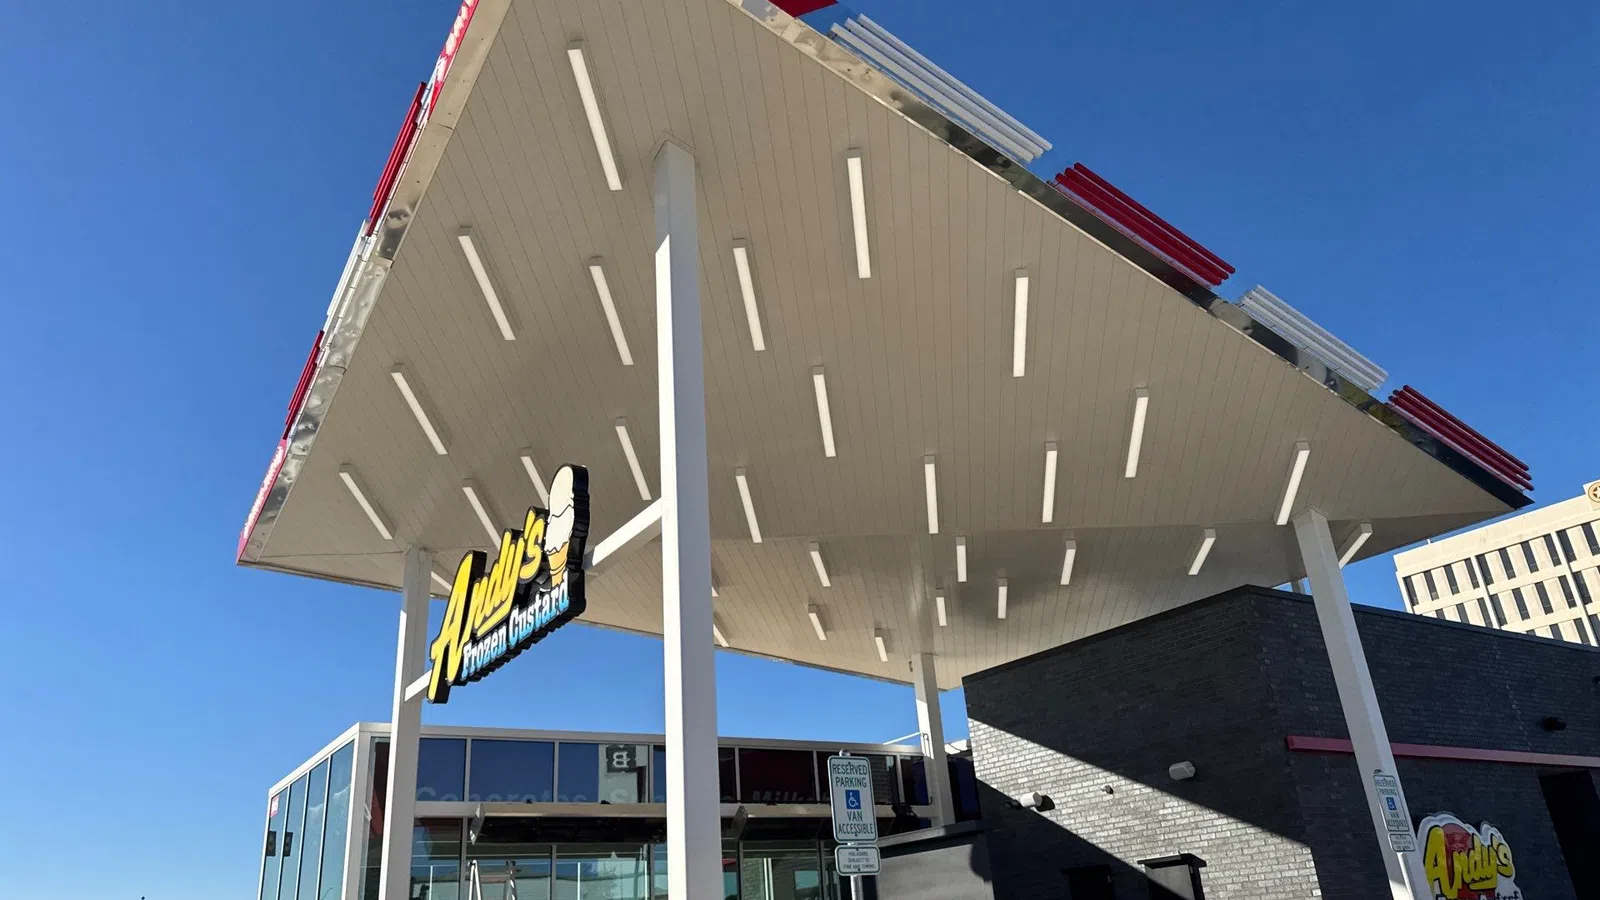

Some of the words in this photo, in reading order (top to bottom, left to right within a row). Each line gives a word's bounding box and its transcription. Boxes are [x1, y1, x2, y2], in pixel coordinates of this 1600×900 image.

[427, 507, 545, 702] Andy's
[461, 625, 507, 681] Frozen
[509, 569, 569, 649] Custard
[832, 763, 868, 775] RESERVED
[835, 776, 867, 788] PARKING
[846, 811, 863, 822] VAN
[838, 823, 874, 835] ACCESSIBLE
[1424, 825, 1514, 900] Andy's
